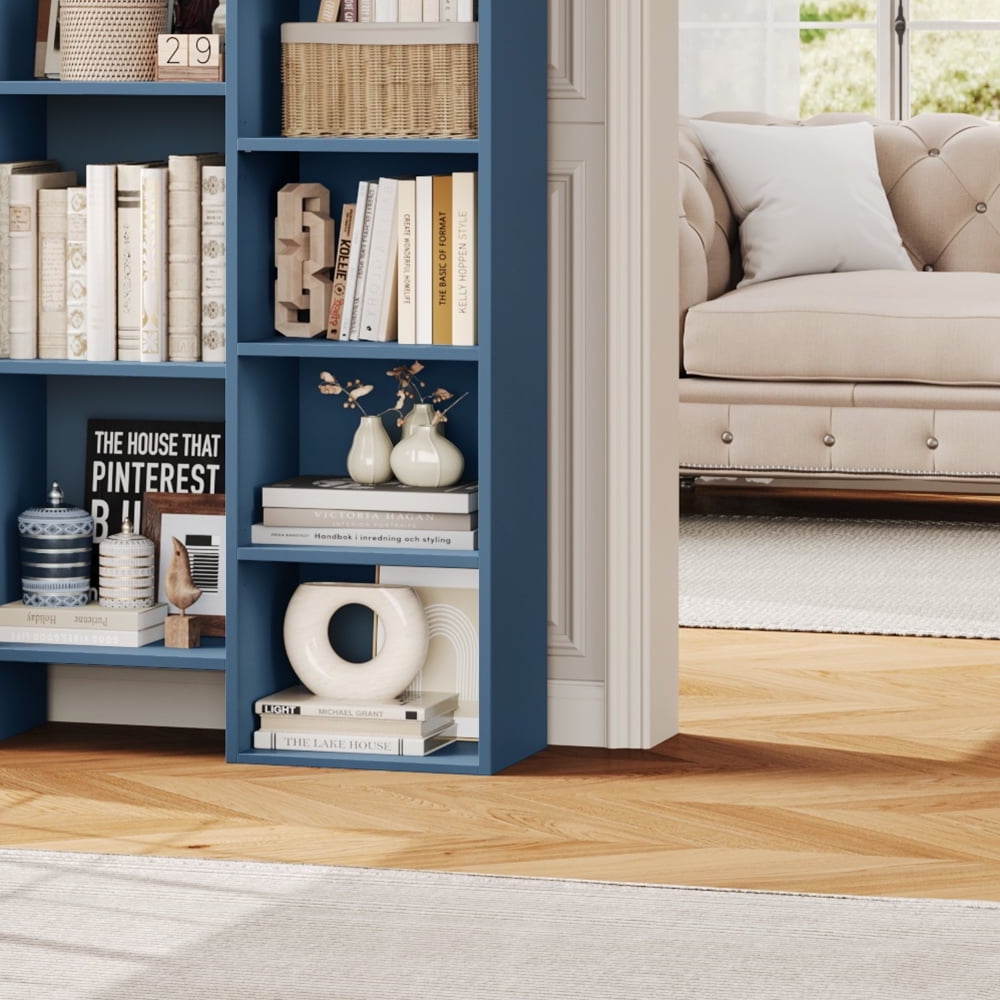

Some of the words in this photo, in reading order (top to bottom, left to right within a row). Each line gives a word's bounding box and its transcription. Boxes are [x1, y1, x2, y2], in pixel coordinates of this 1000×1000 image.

[439, 212, 447, 248] FORMAT
[457, 211, 468, 240] STYLE
[439, 249, 447, 260] OF
[457, 243, 468, 282] HOPPEN
[439, 263, 447, 288] BASIC
[439, 290, 447, 306] THE
[457, 285, 468, 314] KELLY
[95, 430, 123, 454] THE
[127, 432, 179, 456] HOUSE
[182, 433, 221, 457] THAT
[91, 461, 220, 494] PINTEREST
[314, 511, 379, 520] VICTORIA
[386, 512, 435, 521] HAGAN
[315, 533, 352, 541] Handbok
[359, 534, 402, 544] inredning
[422, 535, 451, 545] styling
[26, 610, 56, 625] Holiday
[264, 705, 296, 714] LIGHT
[318, 708, 353, 717] MICHAEL
[356, 710, 384, 718] GRANT
[284, 737, 311, 747] THE
[314, 738, 347, 749] LAKE
[350, 740, 392, 751] HOUSE
